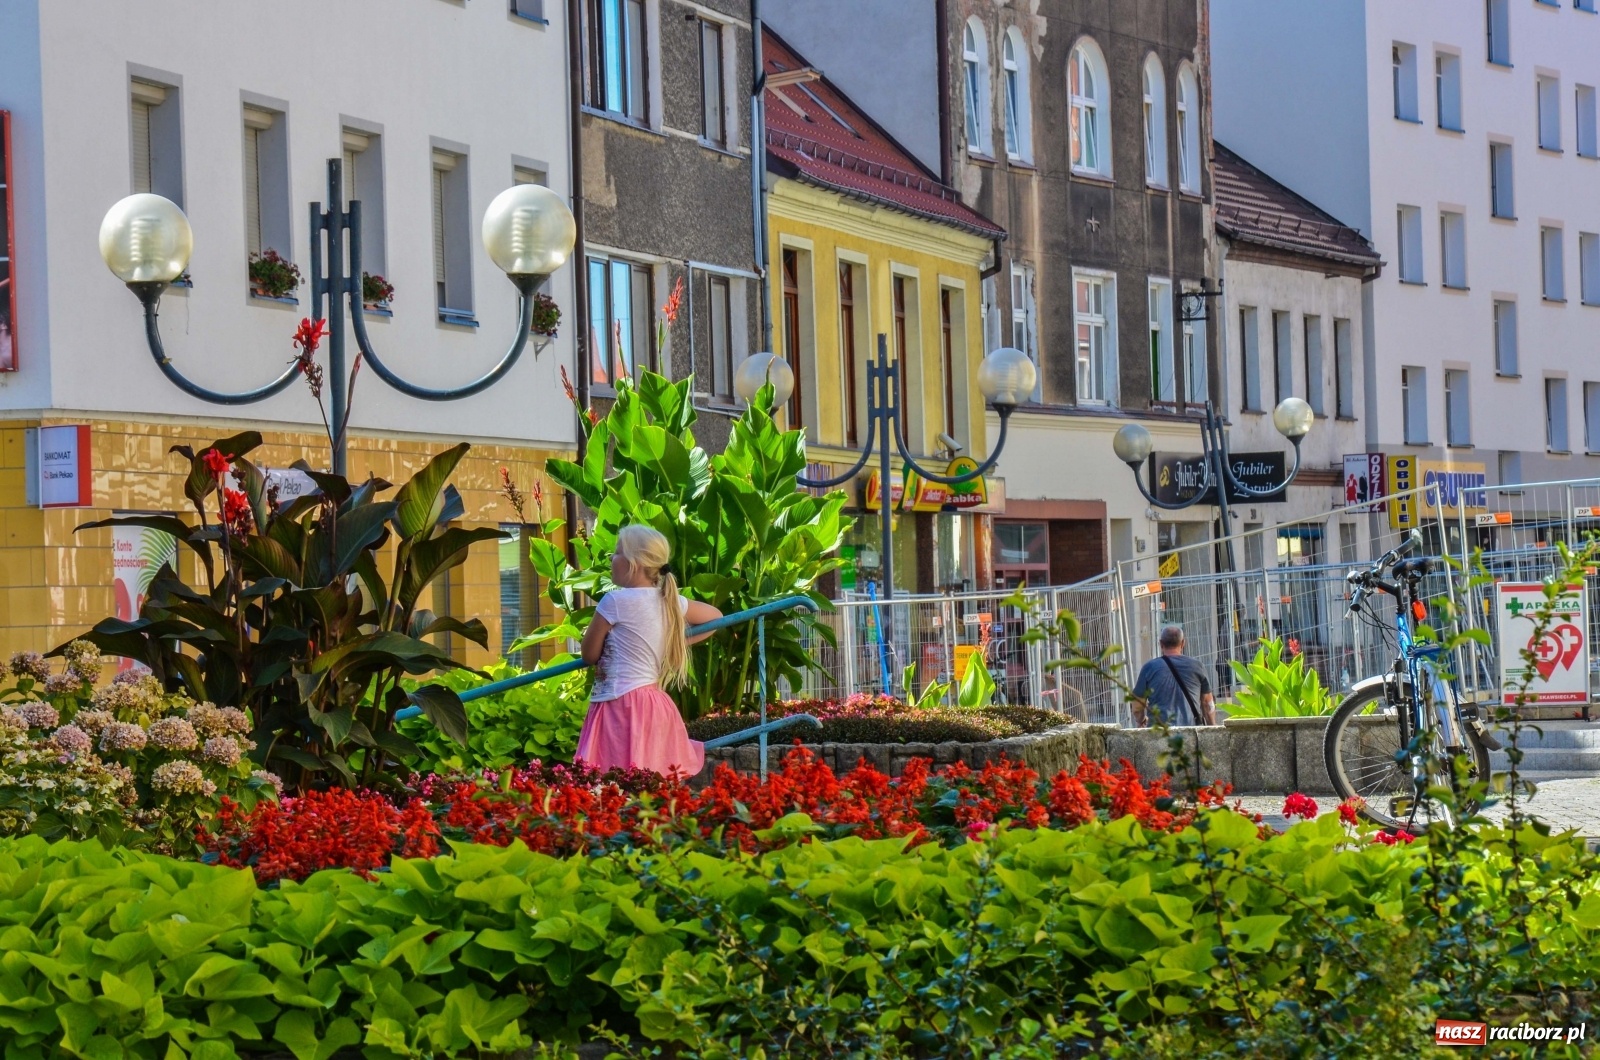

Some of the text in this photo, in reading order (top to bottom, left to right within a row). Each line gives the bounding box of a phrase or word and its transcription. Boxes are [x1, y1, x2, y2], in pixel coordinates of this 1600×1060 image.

[44, 451, 71, 461] BANKOMAT
[49, 470, 73, 479] Bank Pekao
[1174, 461, 1198, 493] Jubiler
[1232, 461, 1275, 479] Jubiler
[283, 478, 302, 495] Pekao
[1396, 459, 1410, 523] OBUWIE
[1425, 469, 1487, 507] OBUWIE
[946, 494, 982, 503] żabka
[116, 539, 132, 552] Konto
[113, 555, 148, 571] zędnościowe
[1525, 600, 1580, 610] APEKA
